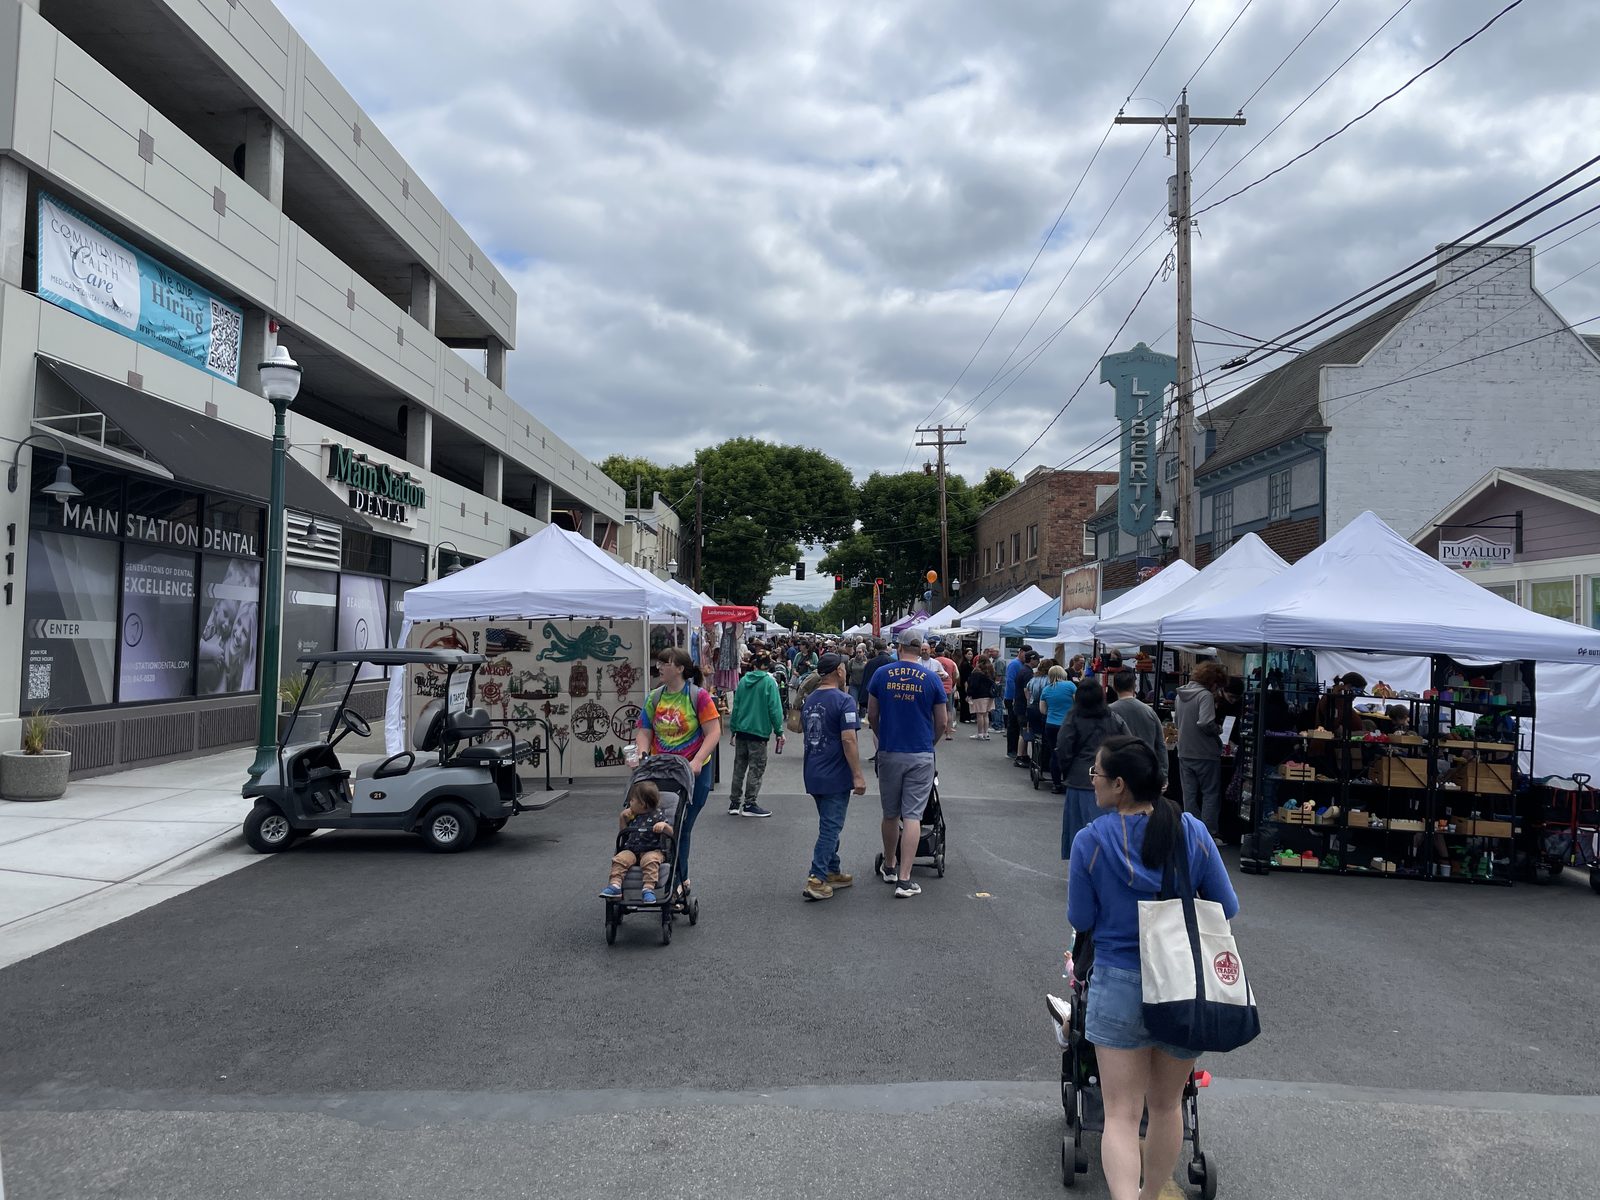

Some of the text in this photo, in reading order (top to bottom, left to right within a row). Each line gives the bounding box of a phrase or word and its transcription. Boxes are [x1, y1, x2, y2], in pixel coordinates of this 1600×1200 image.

[51, 218, 132, 272] COMMUNITY
[72, 245, 114, 294] Care
[155, 265, 193, 298] We are
[152, 281, 204, 335] Hiring
[1130, 377, 1149, 521] LIBERTY
[334, 444, 426, 509] Main Station
[356, 490, 409, 523] DENTAL
[63, 501, 256, 556] MAIN STATION DENTAL
[1443, 546, 1511, 559] PUYALLUP
[124, 576, 195, 597] EXCELLENCE.
[125, 563, 193, 578] GENERATIONS OF DENTAL
[50, 623, 80, 635] ENTER
[886, 682, 923, 692] BASEBALL
[888, 667, 927, 680] SEATTLE
